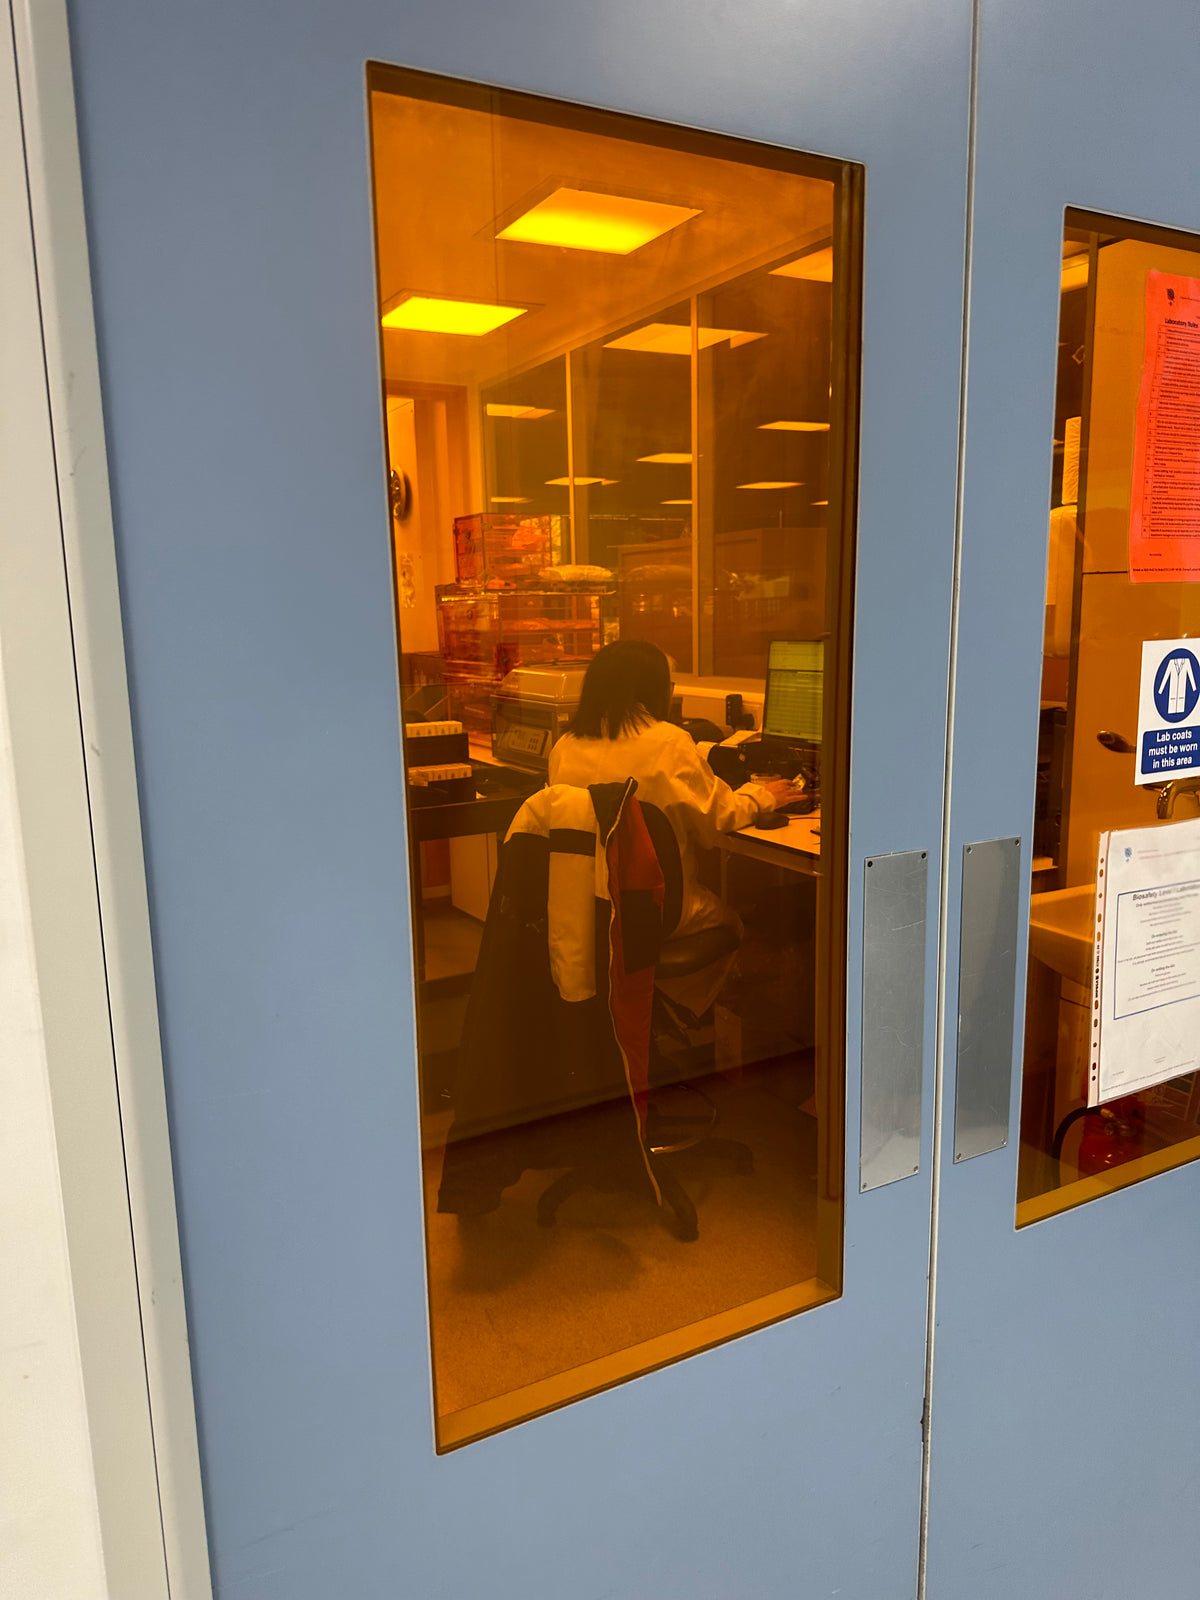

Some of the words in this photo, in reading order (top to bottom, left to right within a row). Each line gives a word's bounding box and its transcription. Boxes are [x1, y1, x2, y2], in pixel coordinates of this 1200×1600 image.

[1156, 731, 1171, 742] Lab
[1172, 730, 1192, 740] coats
[1148, 745, 1168, 757] must
[1168, 744, 1178, 754] be
[1179, 743, 1198, 752] worn
[1152, 759, 1160, 769] in
[1161, 757, 1175, 767] this
[1176, 756, 1192, 766] area
